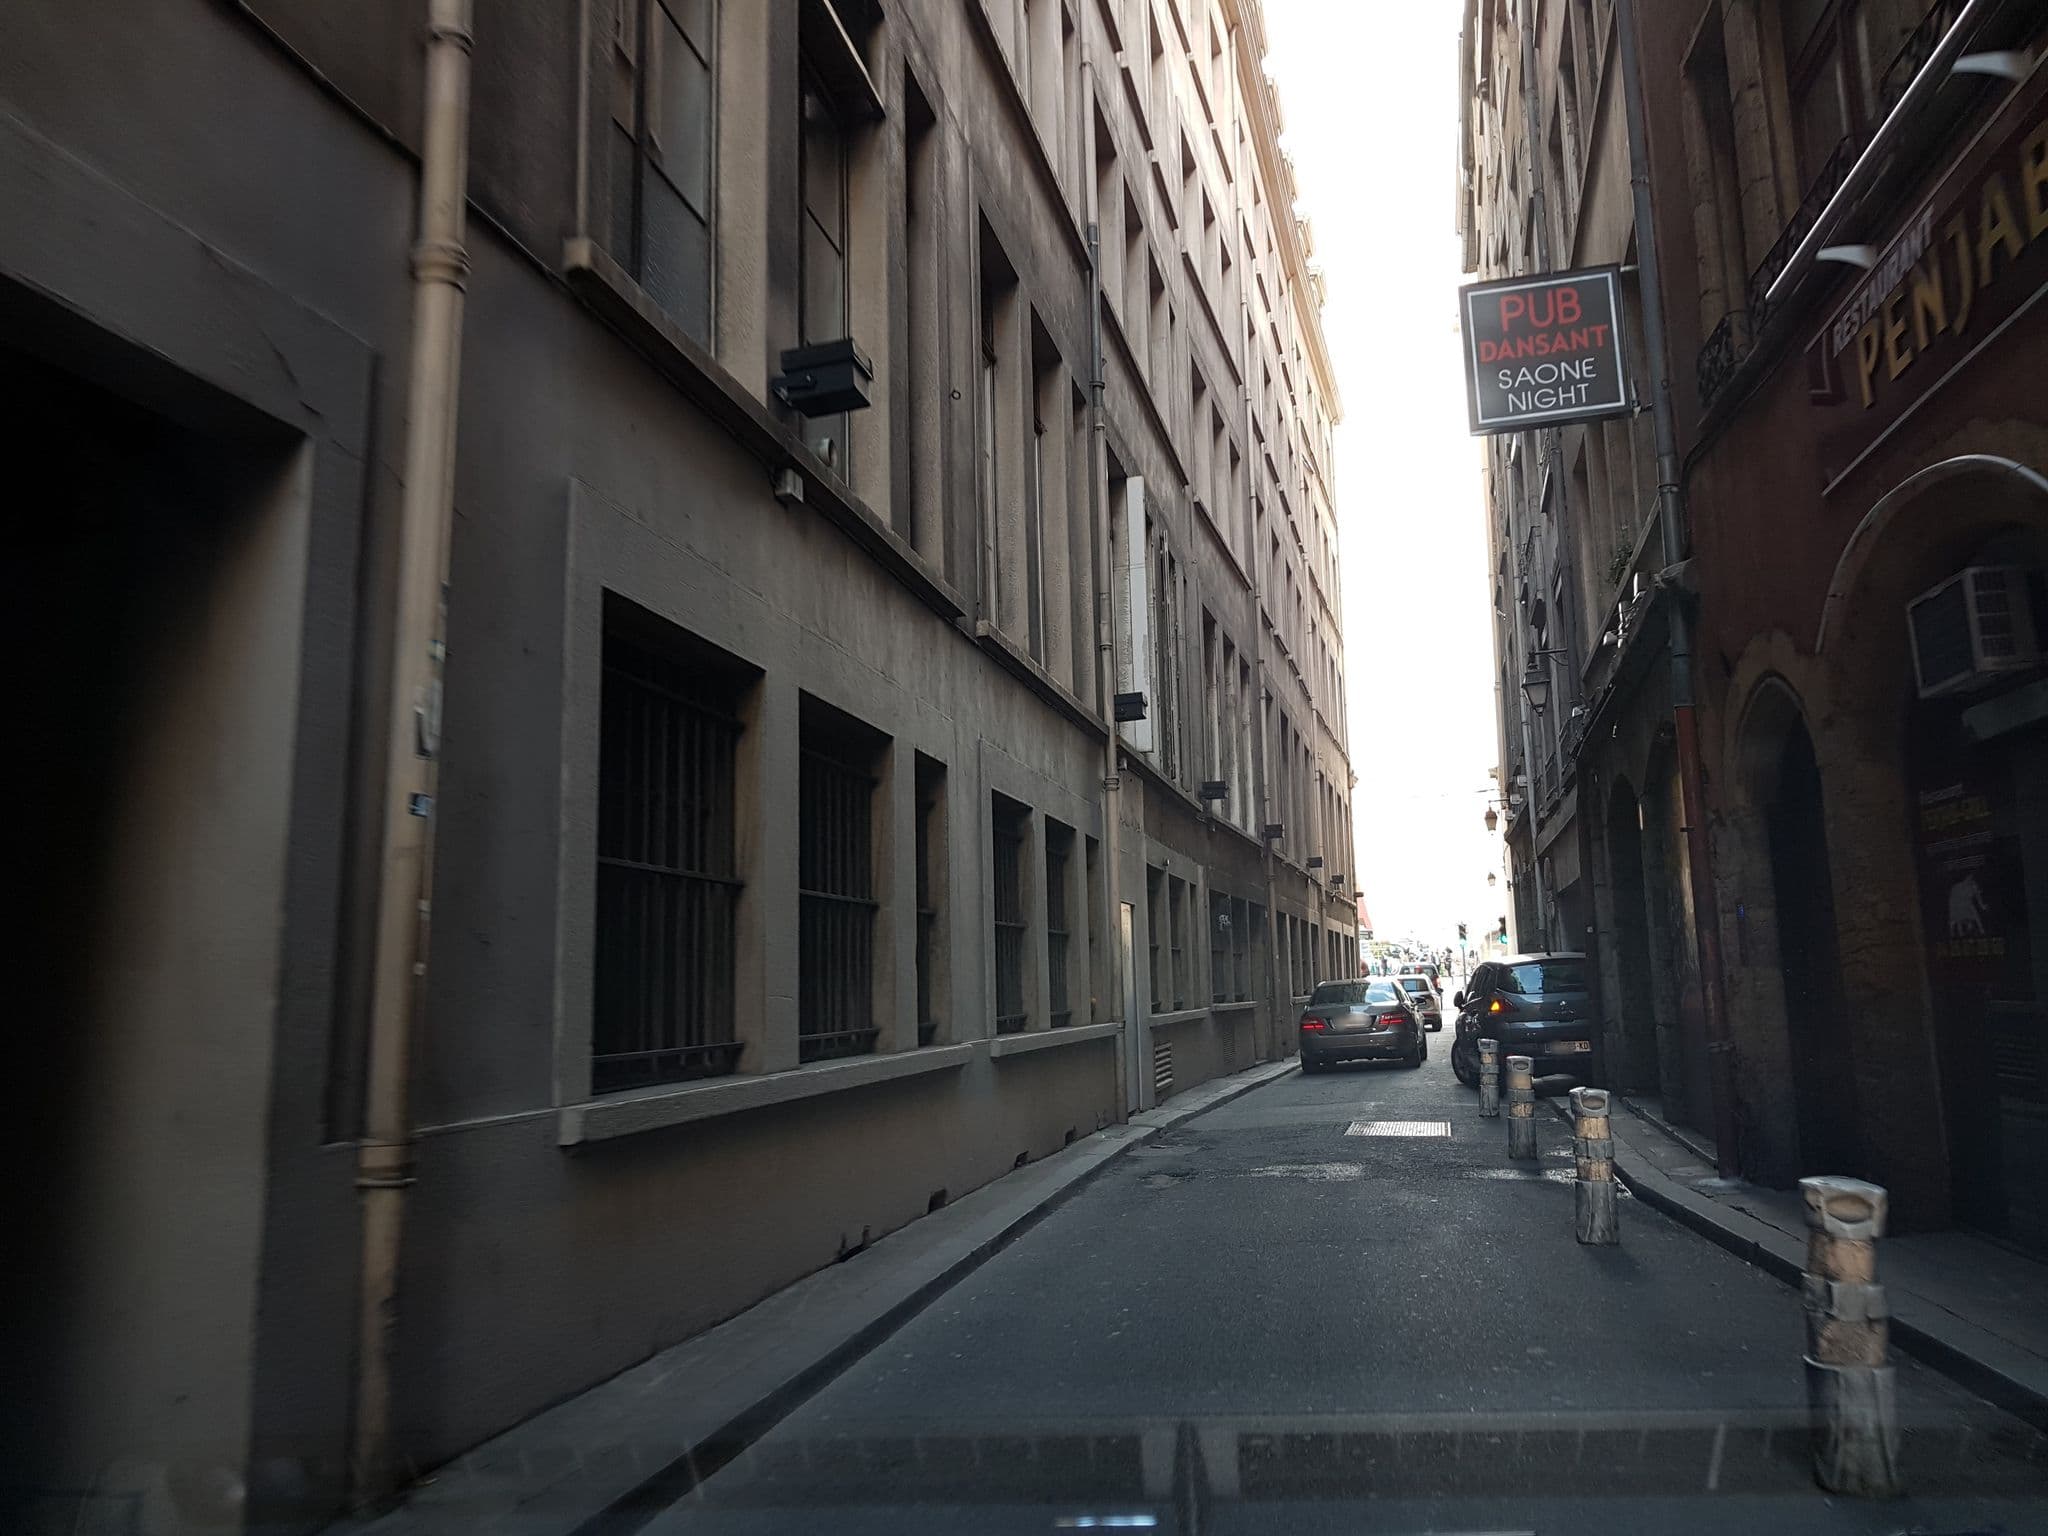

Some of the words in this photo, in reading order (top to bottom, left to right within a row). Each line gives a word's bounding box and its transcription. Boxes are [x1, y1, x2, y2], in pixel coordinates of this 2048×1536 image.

[1499, 288, 1583, 333] PUB
[1479, 325, 1608, 363] DANSANT
[1498, 358, 1597, 389] SAONE
[1508, 383, 1589, 413] NIGHT
